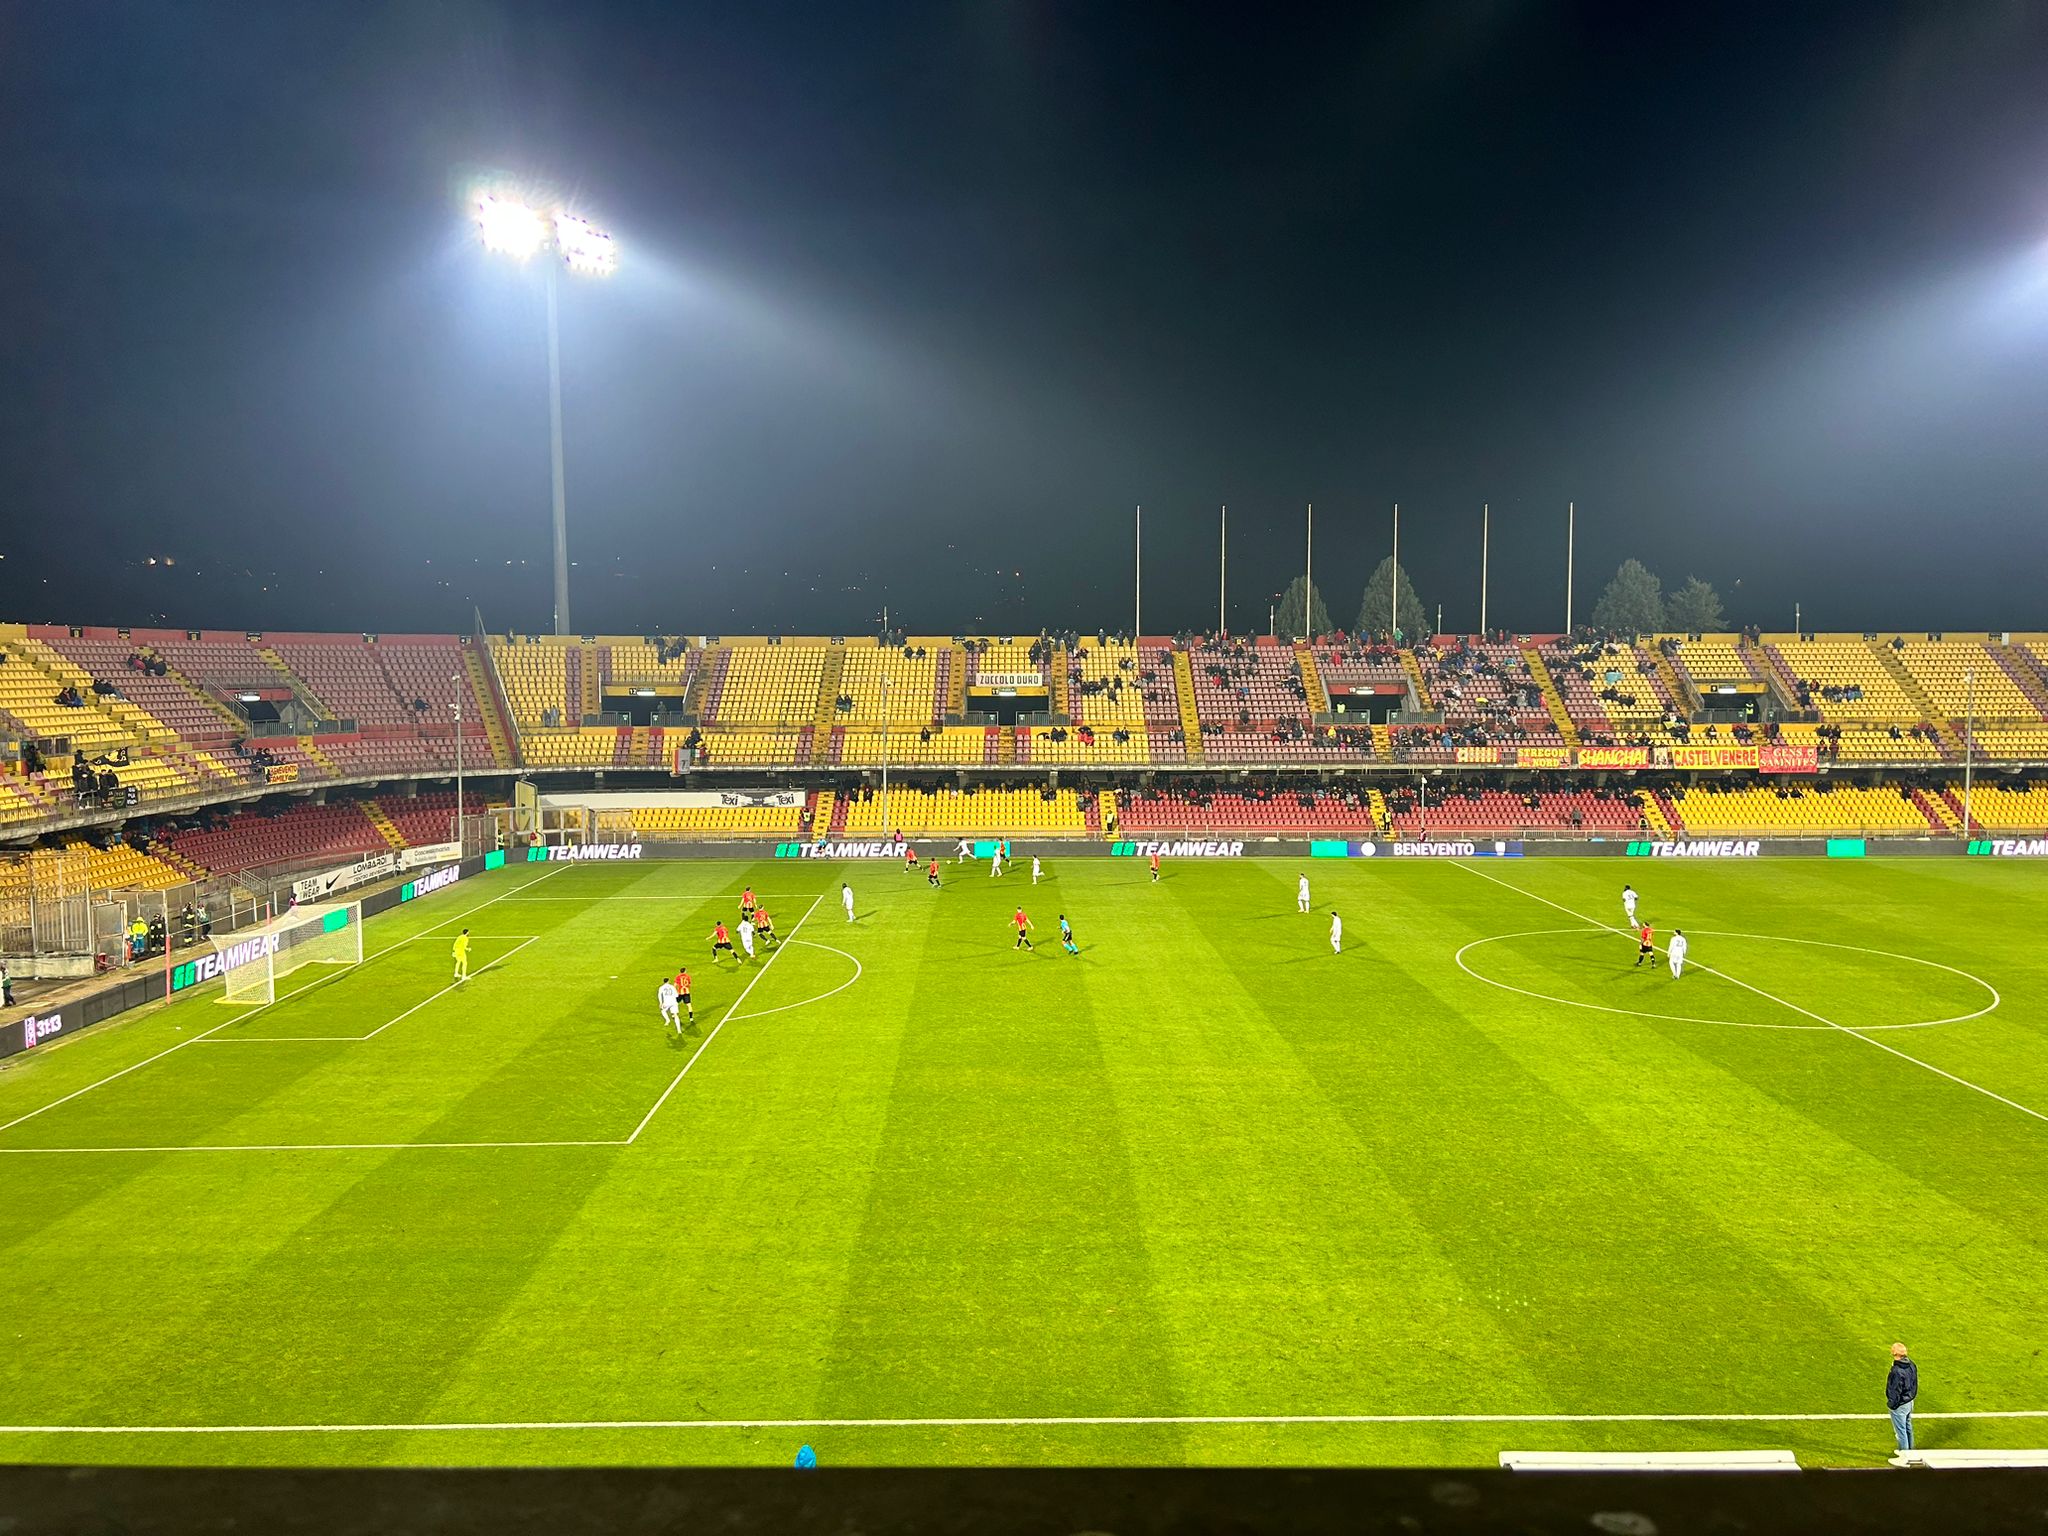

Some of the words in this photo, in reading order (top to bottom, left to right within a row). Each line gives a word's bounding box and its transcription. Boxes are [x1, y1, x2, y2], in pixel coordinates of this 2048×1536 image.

[979, 675, 1015, 685] ZOCCOLO
[1517, 748, 1570, 757] STREGONI
[1579, 748, 1648, 766] SHANGHAI
[1674, 749, 1757, 767] CASTELVENERE
[1773, 748, 1803, 757] GENS
[1532, 757, 1560, 767] NORD
[1760, 757, 1816, 767] SAMNITES
[776, 794, 794, 805] Texi
[548, 844, 642, 860] TEAMWEAR
[800, 842, 908, 858] TEAMWEAR
[1136, 841, 1244, 856] TEAMWEAR
[1393, 842, 1476, 856] BENEVENTO
[1651, 841, 1760, 856] TEAMWEAR
[1992, 840, 2048, 856] TEAM
[352, 856, 388, 875] LOMBARDI
[300, 877, 319, 891] TEAM
[414, 864, 460, 898] TEAMWEAR
[302, 886, 320, 899] WEAR
[195, 932, 280, 983] TEAMWEAR
